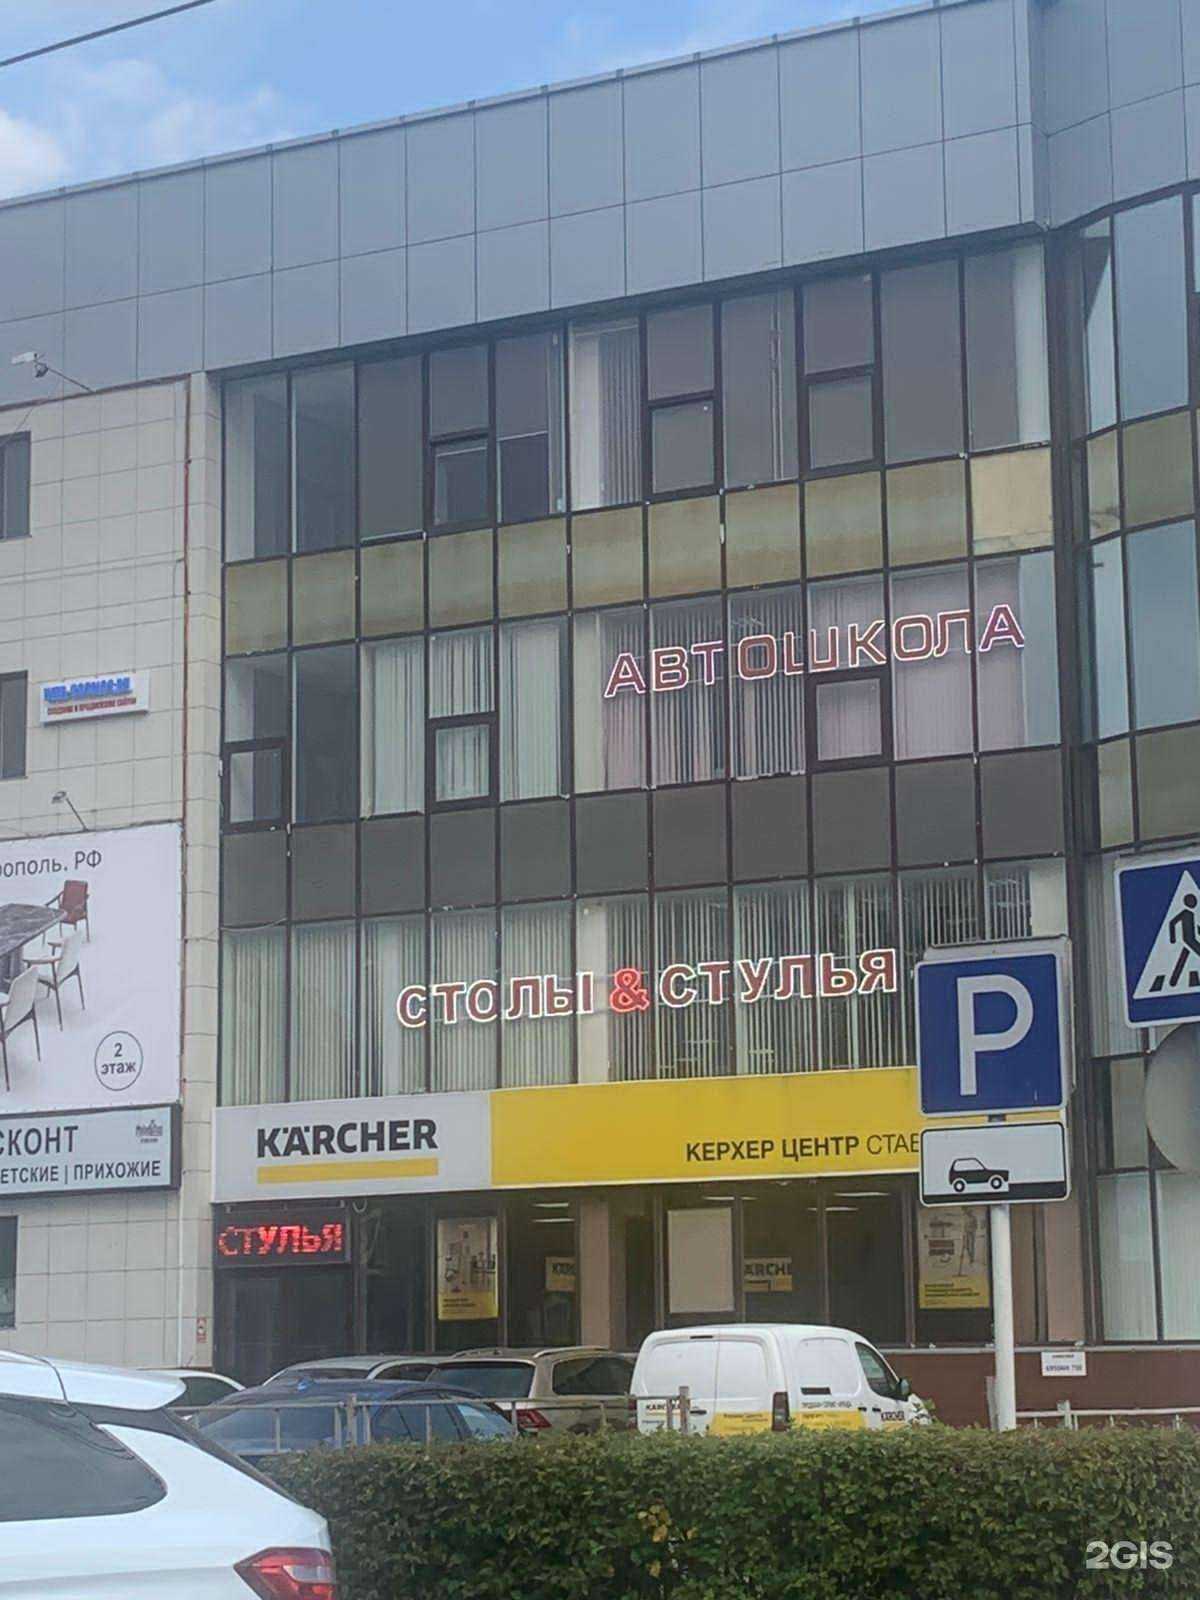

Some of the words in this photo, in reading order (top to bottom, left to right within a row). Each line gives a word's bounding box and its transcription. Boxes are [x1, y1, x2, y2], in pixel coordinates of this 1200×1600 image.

[603, 603, 1026, 698] АВТОШКОЛА
[0, 858, 68, 878] ополь.
[74, 849, 102, 870] РФ
[396, 971, 595, 1028] СТОЛЫ
[608, 967, 650, 1013] &
[658, 948, 898, 1008] СТУЛЬЯ
[113, 1042, 123, 1058] 2
[957, 974, 1034, 1096] P
[100, 1060, 137, 1076] этаж
[256, 1118, 439, 1159] KÄRCHER
[686, 1139, 775, 1162] КЕРХЕР
[782, 1135, 860, 1162] ЦЕНТР
[74, 1160, 161, 1181] ПРИХОЖИЕ
[217, 1222, 343, 1257] СТУЛЬЯ
